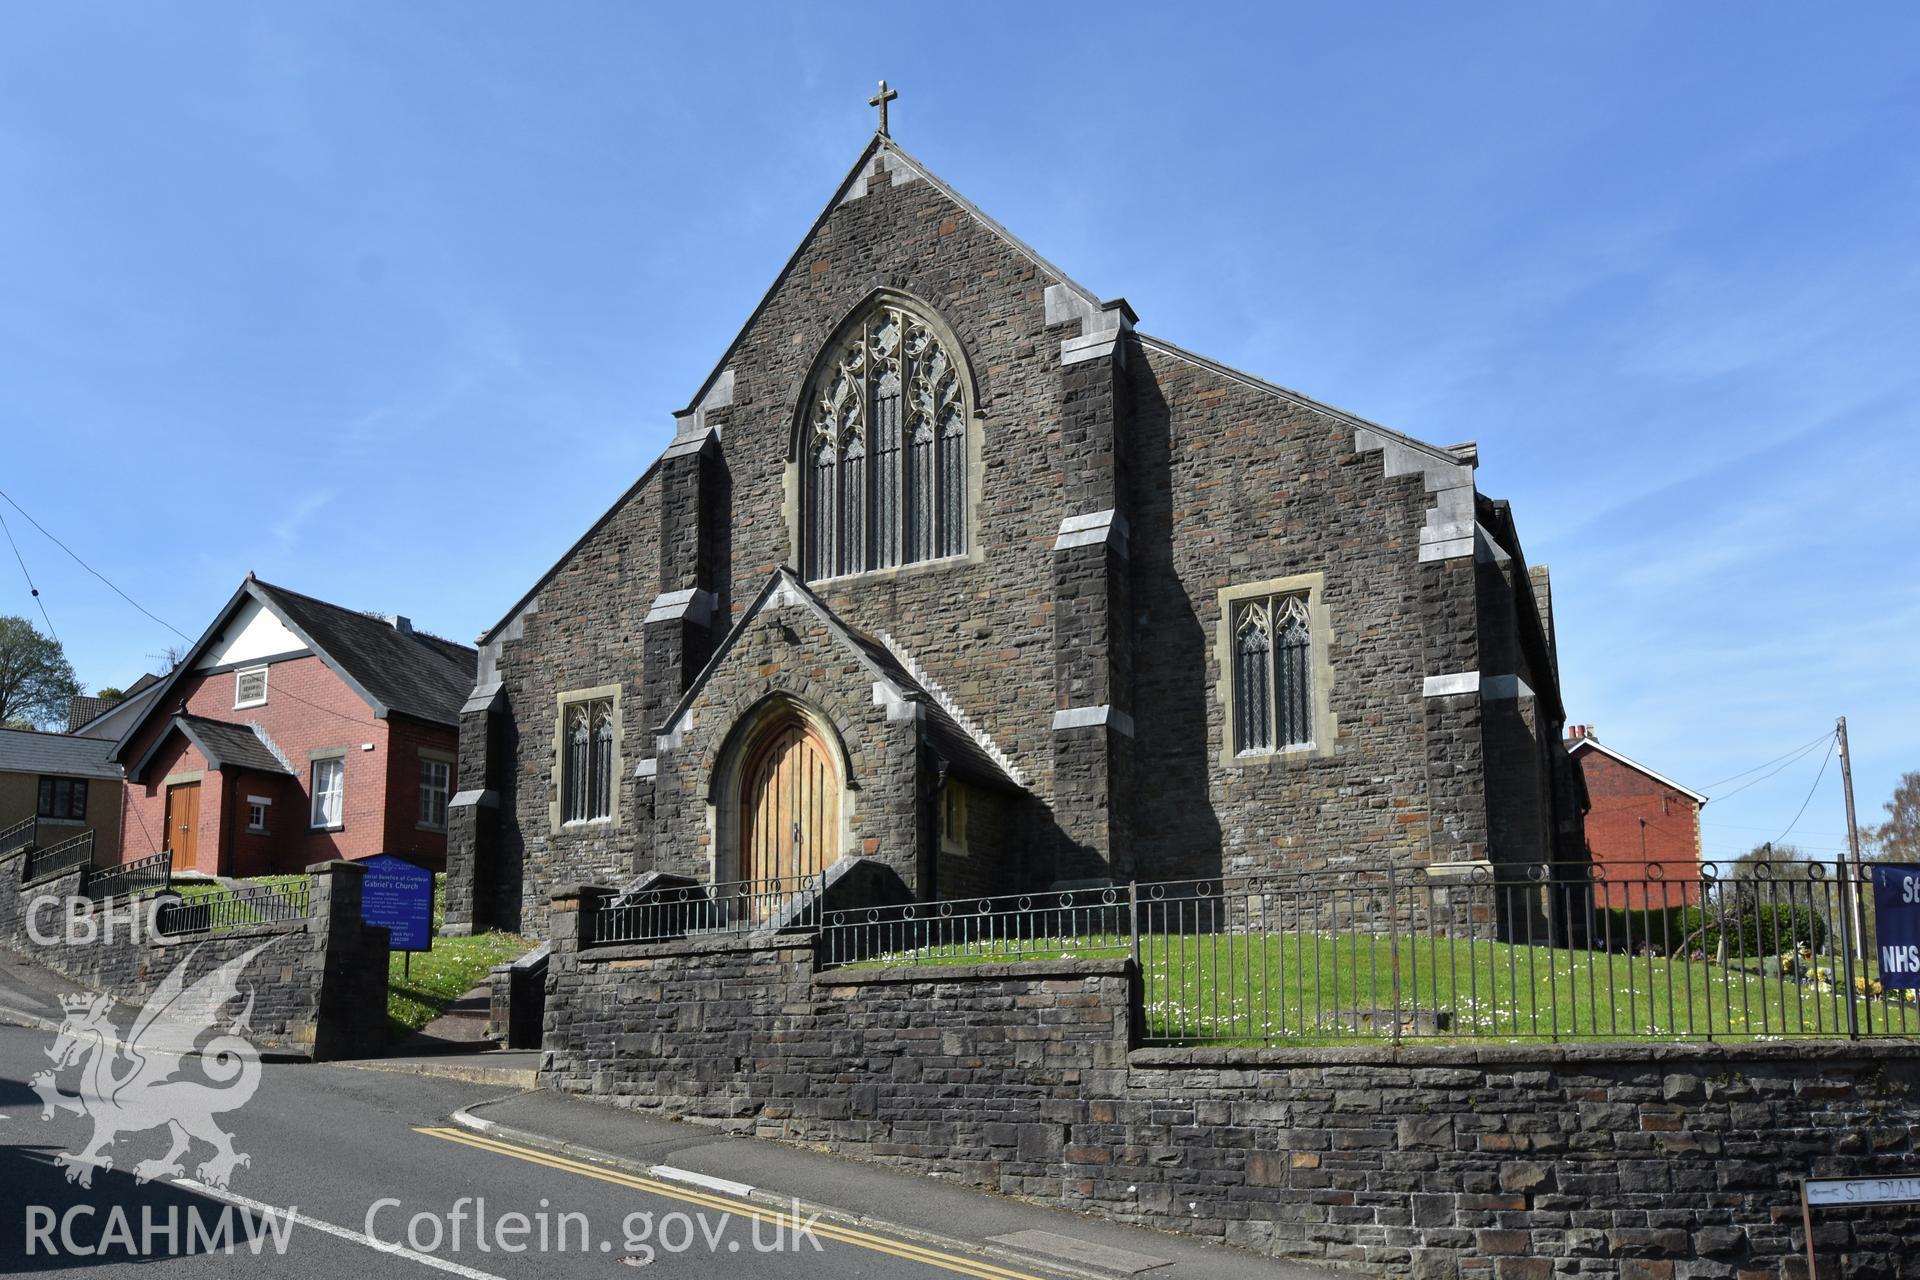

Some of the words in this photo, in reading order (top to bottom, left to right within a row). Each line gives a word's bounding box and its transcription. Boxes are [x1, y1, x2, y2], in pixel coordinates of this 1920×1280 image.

[364, 880, 393, 889] Gabriel's
[395, 881, 419, 890] Church
[1882, 945, 1920, 973] NHS
